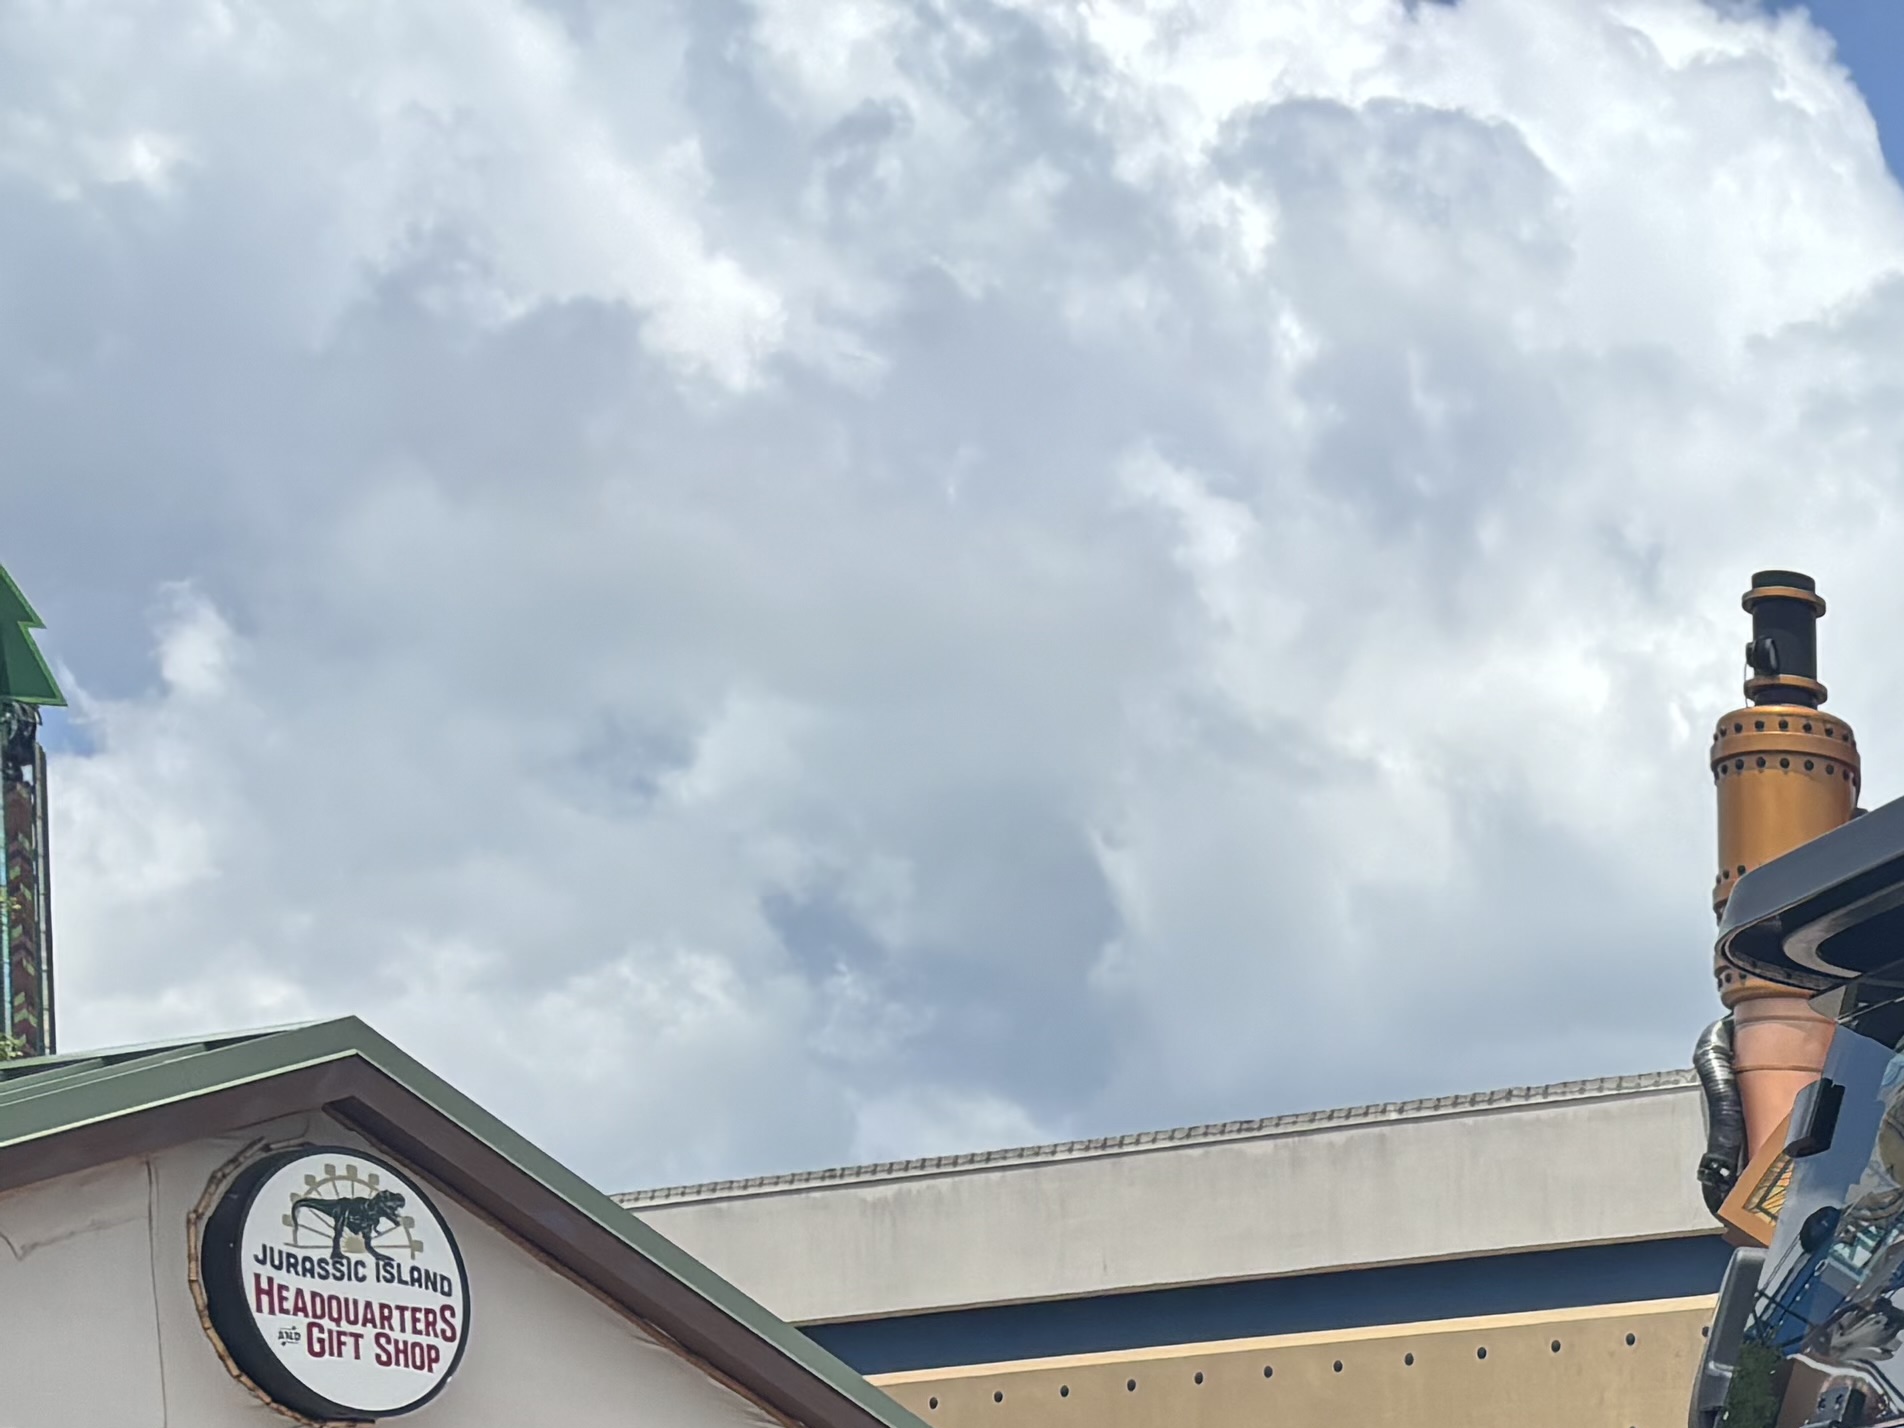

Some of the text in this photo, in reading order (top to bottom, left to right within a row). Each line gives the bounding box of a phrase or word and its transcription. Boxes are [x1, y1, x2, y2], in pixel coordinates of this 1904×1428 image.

[253, 1244, 453, 1297] JURASSIC ISLAND
[253, 1273, 457, 1343] HEADQUARTERS
[306, 1321, 364, 1360] GIFT
[374, 1331, 441, 1374] SHOP
